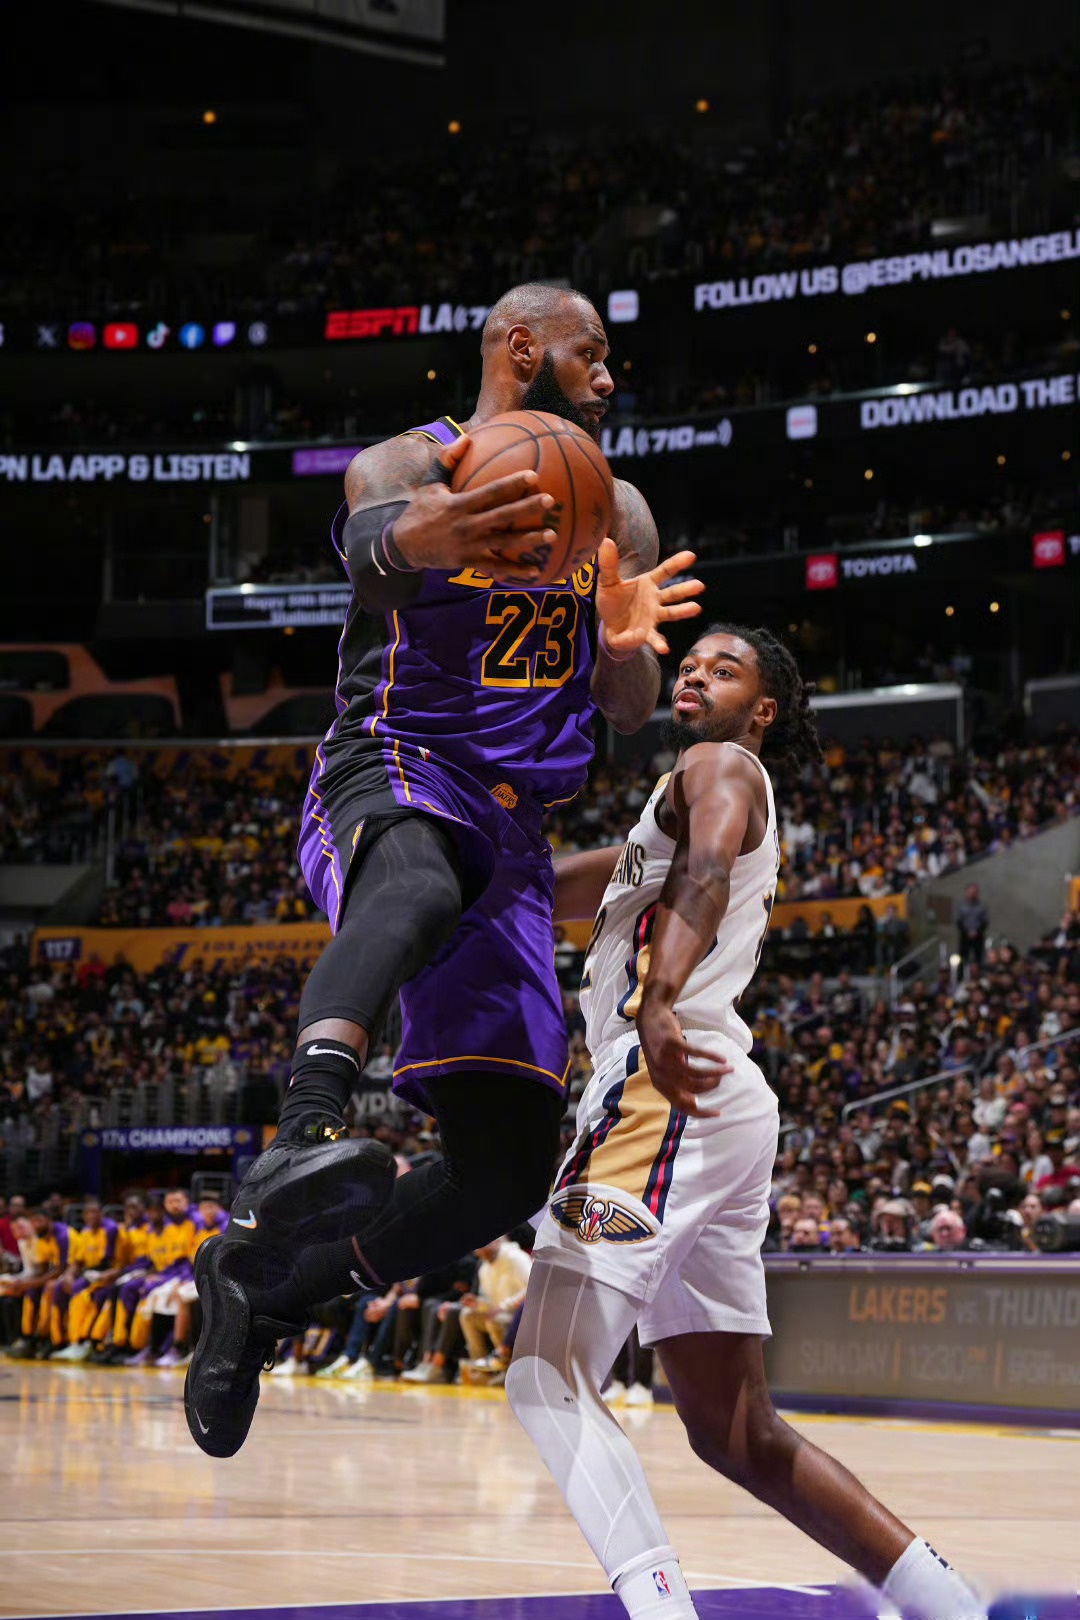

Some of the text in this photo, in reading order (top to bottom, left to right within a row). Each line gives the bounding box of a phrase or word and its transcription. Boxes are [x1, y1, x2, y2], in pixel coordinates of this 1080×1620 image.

[694, 271, 799, 310] FOLLOW
[801, 266, 838, 295] US
[861, 386, 1019, 430] DOWNLOAD
[1020, 374, 1075, 410] THE
[32, 455, 66, 480] LA
[68, 455, 125, 480] APP
[128, 455, 149, 480] &
[153, 454, 250, 480] LISTEN
[841, 554, 917, 578] TOYOTA
[481, 591, 578, 688] 23
[44, 940, 74, 960] 117
[129, 1127, 233, 1150] CHAMPIONS
[849, 1286, 948, 1324] LAKERS
[800, 1339, 889, 1377] SUNDAY
